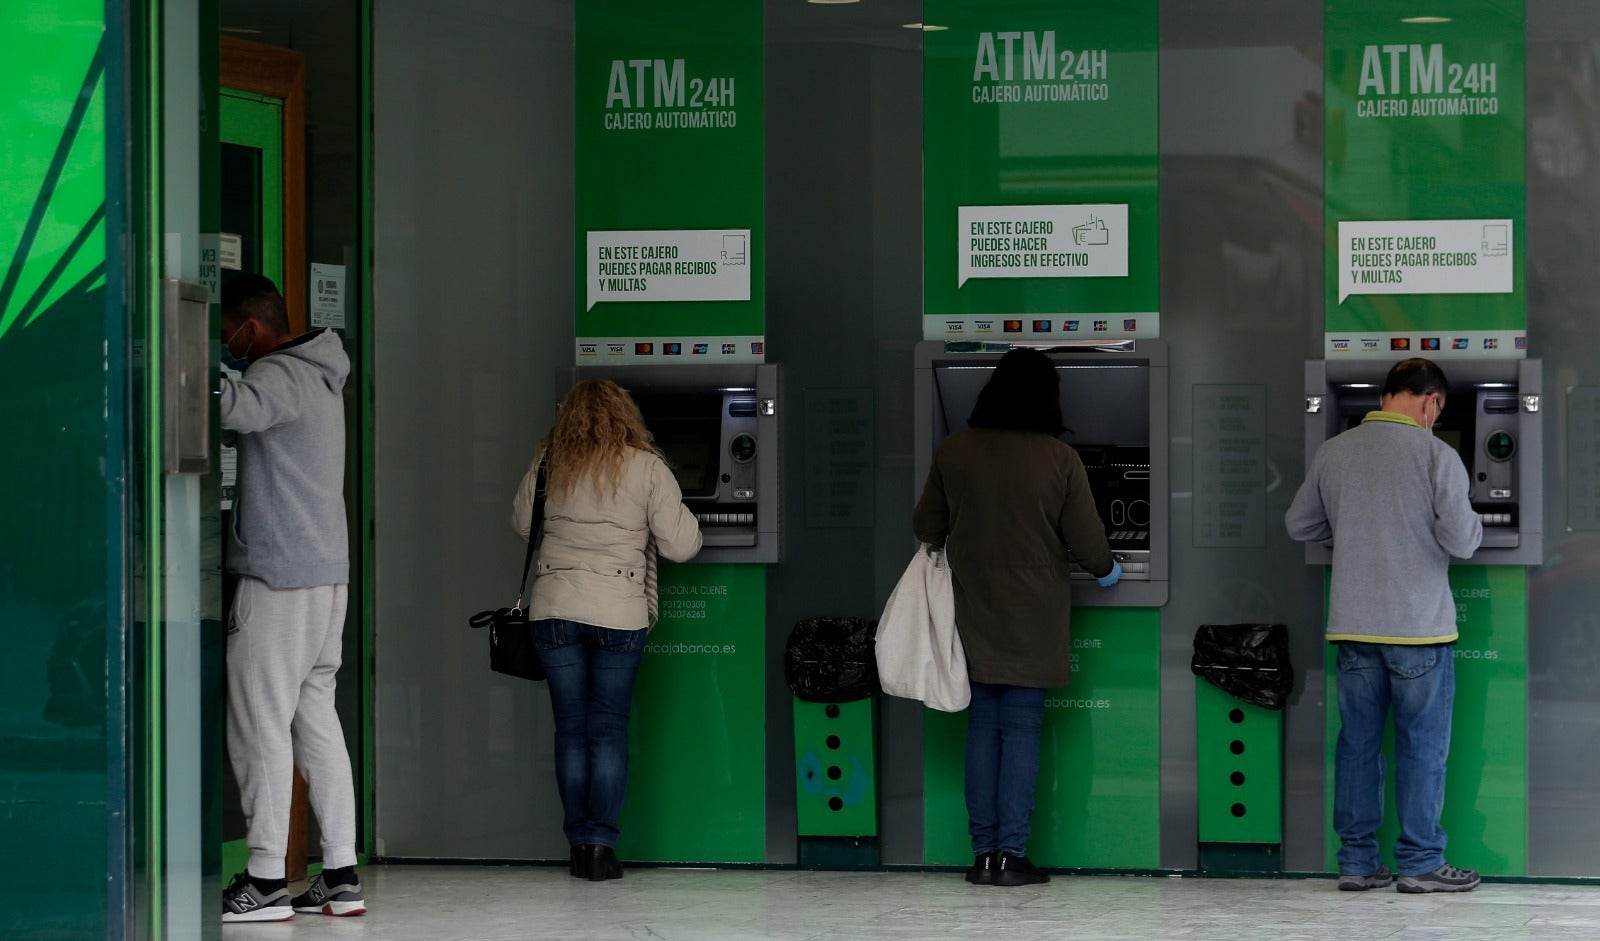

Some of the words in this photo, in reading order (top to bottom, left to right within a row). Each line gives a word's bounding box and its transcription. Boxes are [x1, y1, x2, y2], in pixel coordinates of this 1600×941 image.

[973, 31, 1056, 81] ATM
[1060, 50, 1107, 80] 24H
[1358, 44, 1443, 95] ATM
[1448, 63, 1497, 94] 24H
[606, 59, 685, 108] ATM
[689, 78, 735, 108] 24H
[972, 85, 1021, 103] CAJERO
[1024, 81, 1108, 102] AUTOMÁTICO
[1357, 99, 1408, 117] CAJERO
[1411, 95, 1498, 116] AUTOMÁTICO
[604, 112, 652, 130] CAJERO
[655, 108, 737, 129] AUTOMÁTICO
[971, 222, 984, 235] EN
[987, 221, 1012, 235] ESTE
[1015, 221, 1053, 234] CAJERO
[971, 238, 1010, 251] PUEDES
[1013, 237, 1047, 251] HACER
[1351, 238, 1365, 251] EN
[1368, 237, 1394, 250] ESTE
[1396, 237, 1436, 250] CAJERO
[599, 247, 611, 259] EN
[614, 246, 638, 260] ESTE
[641, 246, 678, 259] CAJERO
[971, 254, 1021, 267] INGRESOS
[1024, 254, 1037, 267] EN
[1040, 253, 1089, 267] EFECTIVO
[1351, 254, 1392, 267] PUEDES
[1395, 253, 1430, 267] PAGAR
[1432, 253, 1477, 266] RECIBOS
[599, 262, 636, 276] PUEDES
[639, 262, 672, 275] PAGAR
[675, 261, 717, 275] RECIBOS
[1351, 270, 1358, 283] Y
[1361, 270, 1402, 283] MULTAS
[599, 279, 605, 291] Y
[608, 278, 647, 292] MULTAS
[643, 642, 736, 656] nicajabanco.es
[1044, 697, 1110, 709] abanco.es
